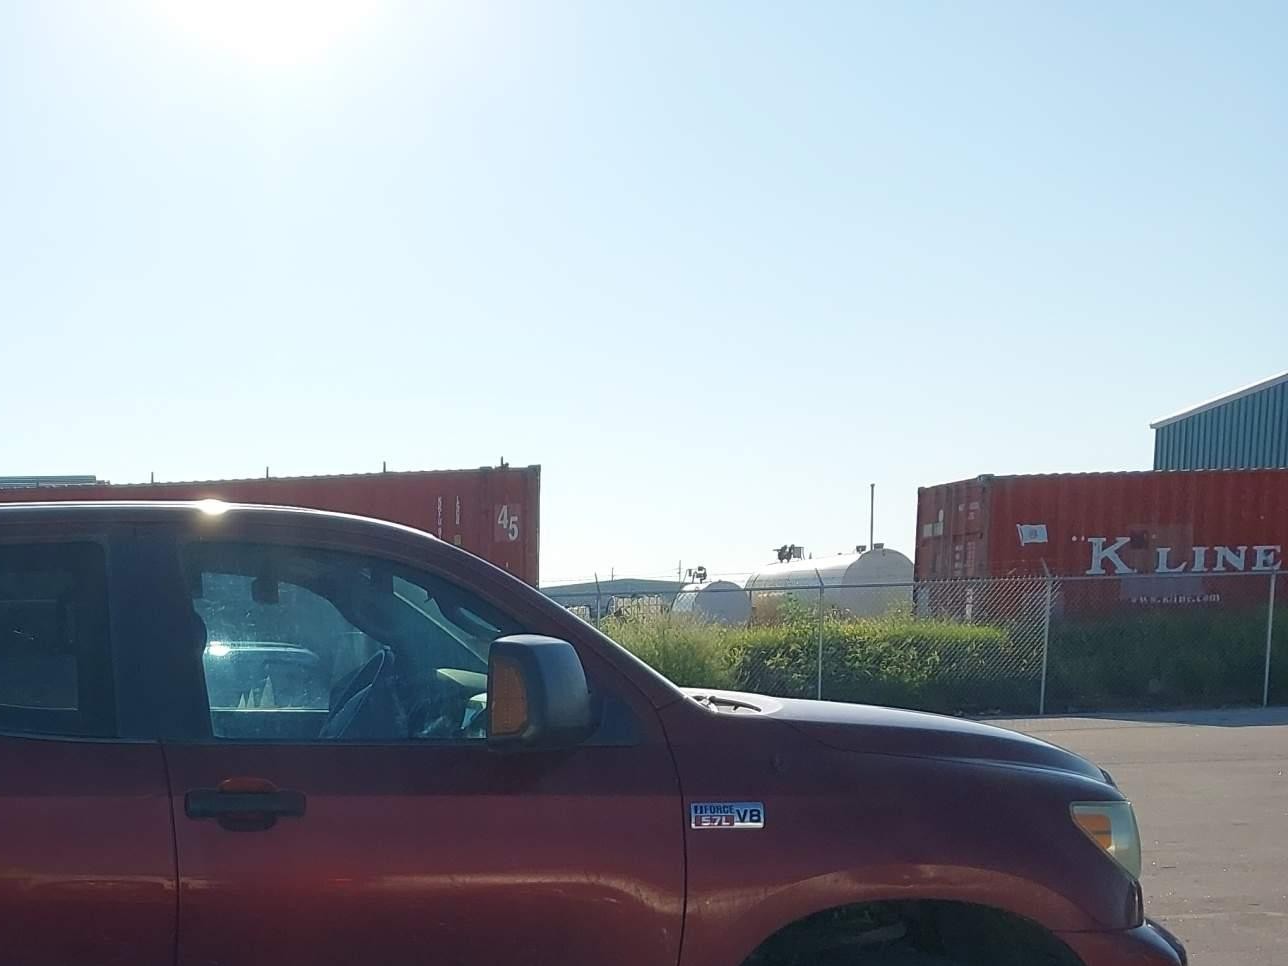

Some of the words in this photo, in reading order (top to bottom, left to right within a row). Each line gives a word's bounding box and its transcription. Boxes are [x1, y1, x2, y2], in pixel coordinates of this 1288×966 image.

[497, 505, 519, 541] 45
[1155, 545, 1282, 573] LINE
[735, 809, 761, 823] V8
